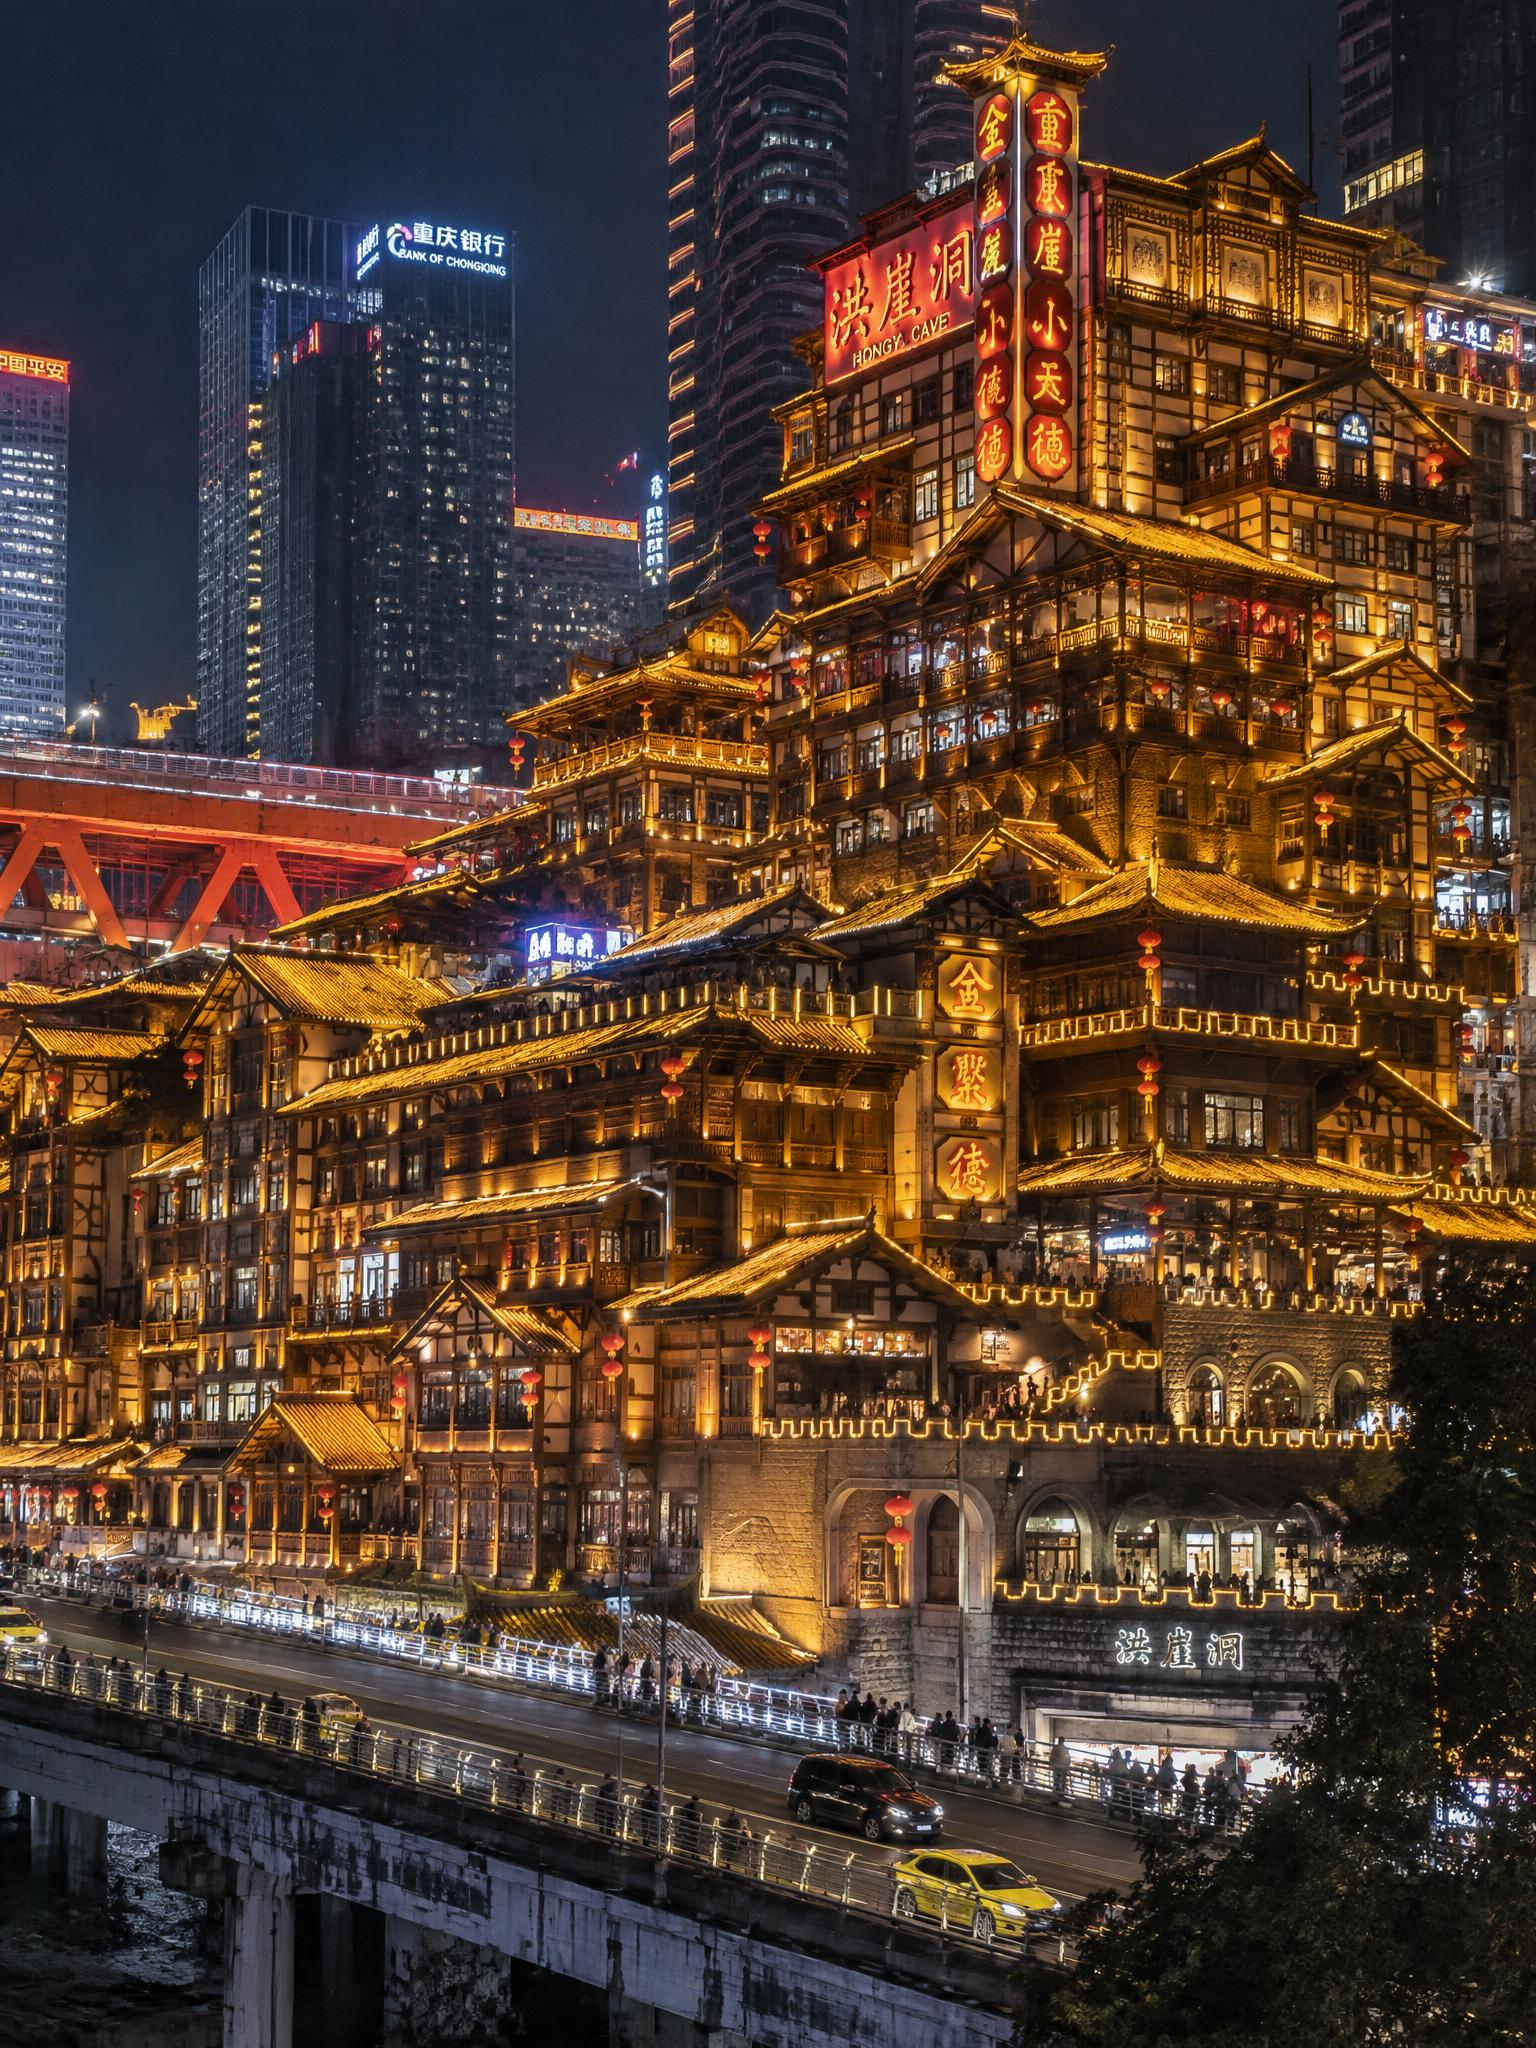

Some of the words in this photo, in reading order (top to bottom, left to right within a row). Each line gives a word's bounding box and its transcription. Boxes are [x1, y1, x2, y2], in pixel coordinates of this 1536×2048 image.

[399, 248, 427, 263] BANK
[429, 252, 444, 265] OF
[413, 221, 505, 258] 重庆银行
[829, 230, 972, 349] 洪崖洞
[911, 311, 951, 342] CAVE
[1115, 1626, 1243, 1671] 洪崖洞
